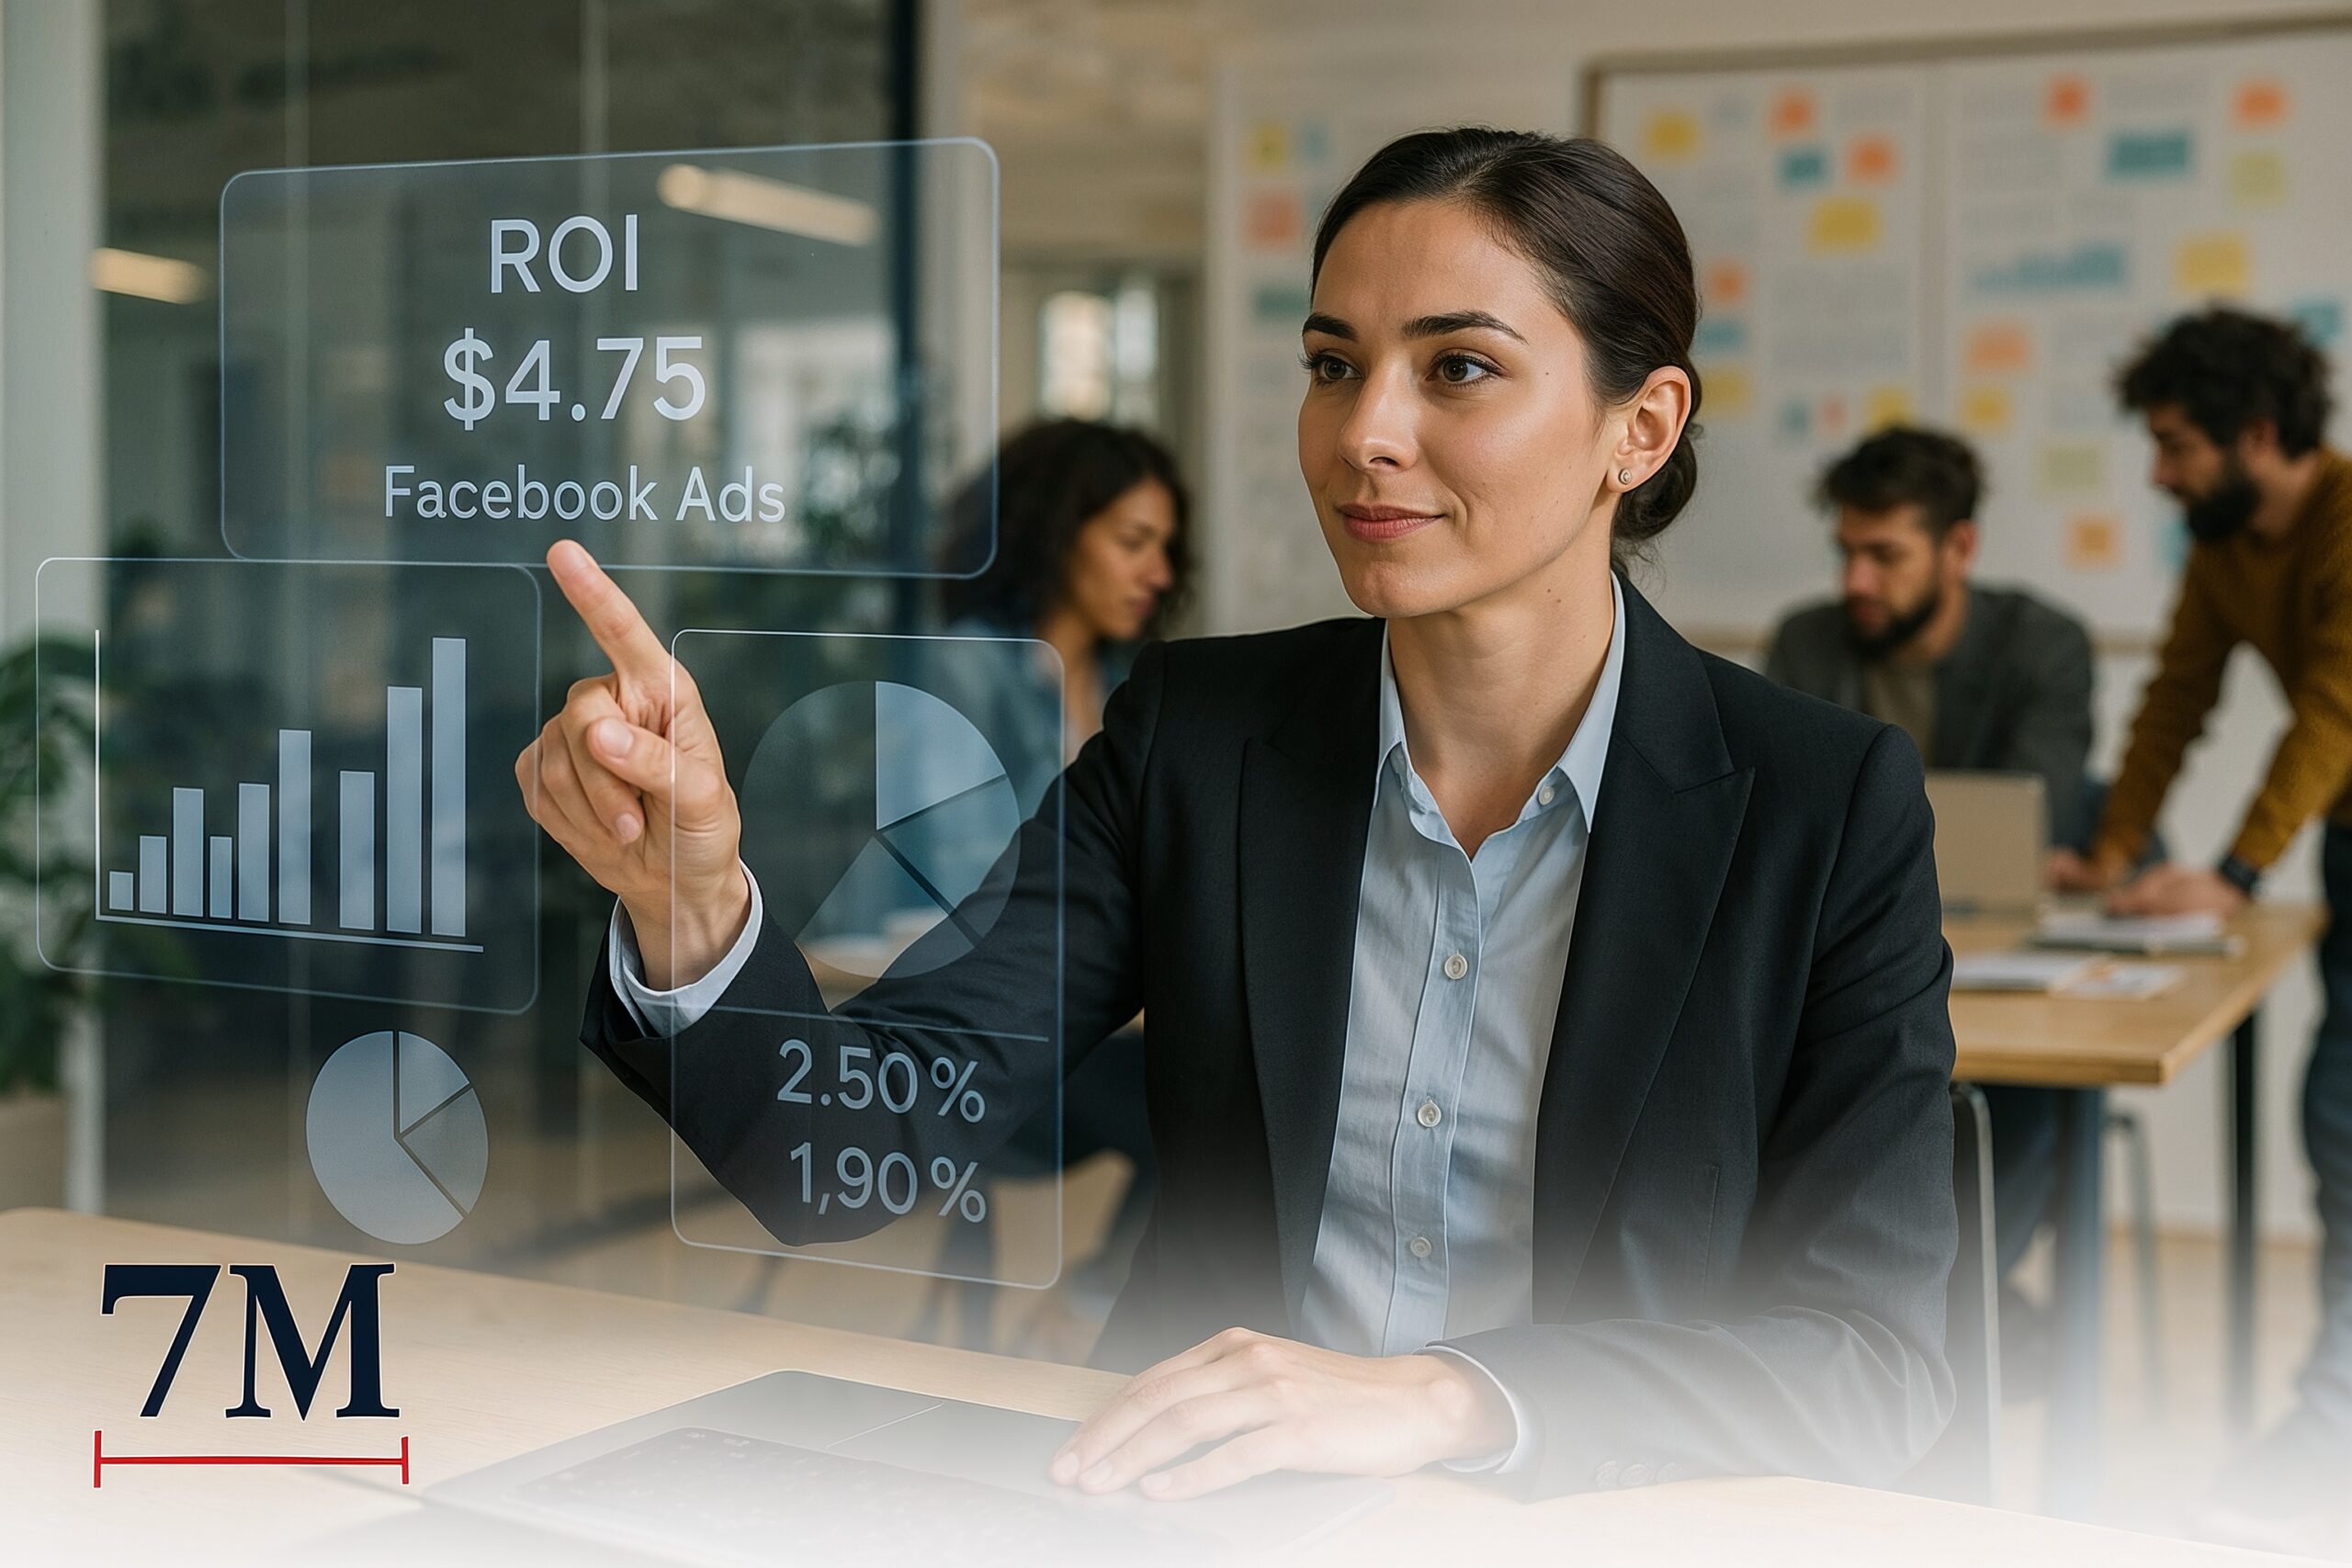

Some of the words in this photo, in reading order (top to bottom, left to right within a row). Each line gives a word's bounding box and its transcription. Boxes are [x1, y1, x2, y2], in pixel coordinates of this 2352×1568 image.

[490, 214, 639, 293] ROI
[443, 327, 706, 431] $4.75
[385, 464, 660, 521] Facebook
[675, 466, 786, 523] Ads
